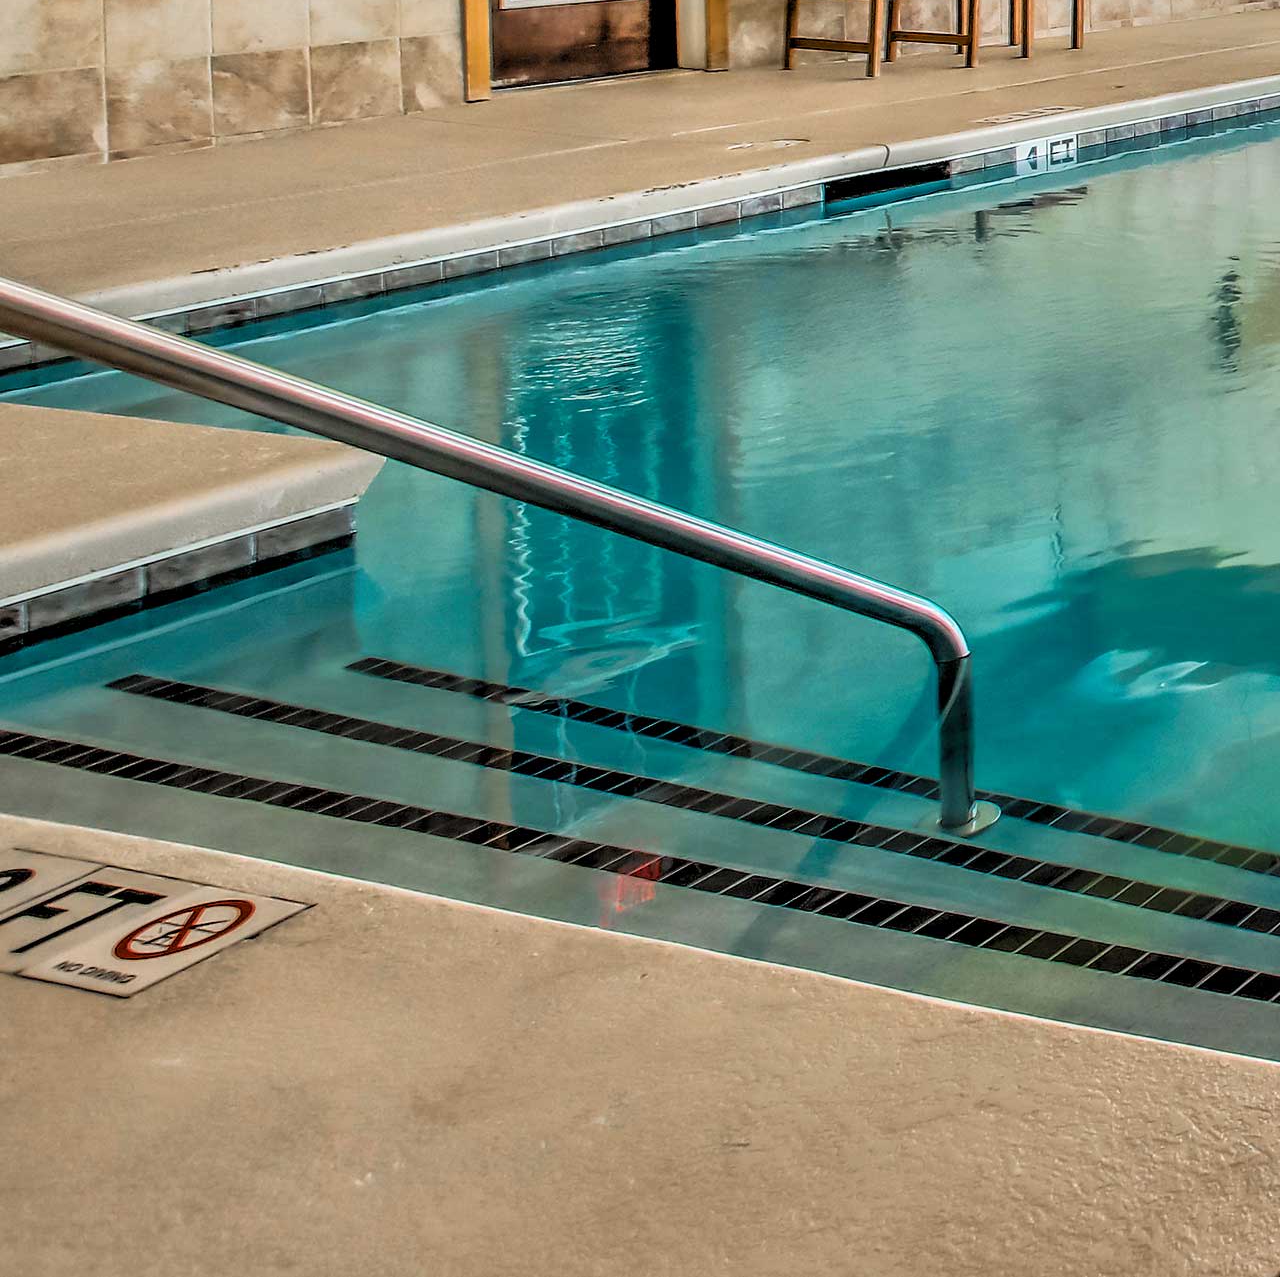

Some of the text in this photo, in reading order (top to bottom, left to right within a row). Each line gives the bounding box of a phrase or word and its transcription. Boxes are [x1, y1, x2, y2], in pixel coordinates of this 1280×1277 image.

[0, 881, 169, 953] FT
[54, 961, 137, 984] NO DIVING
